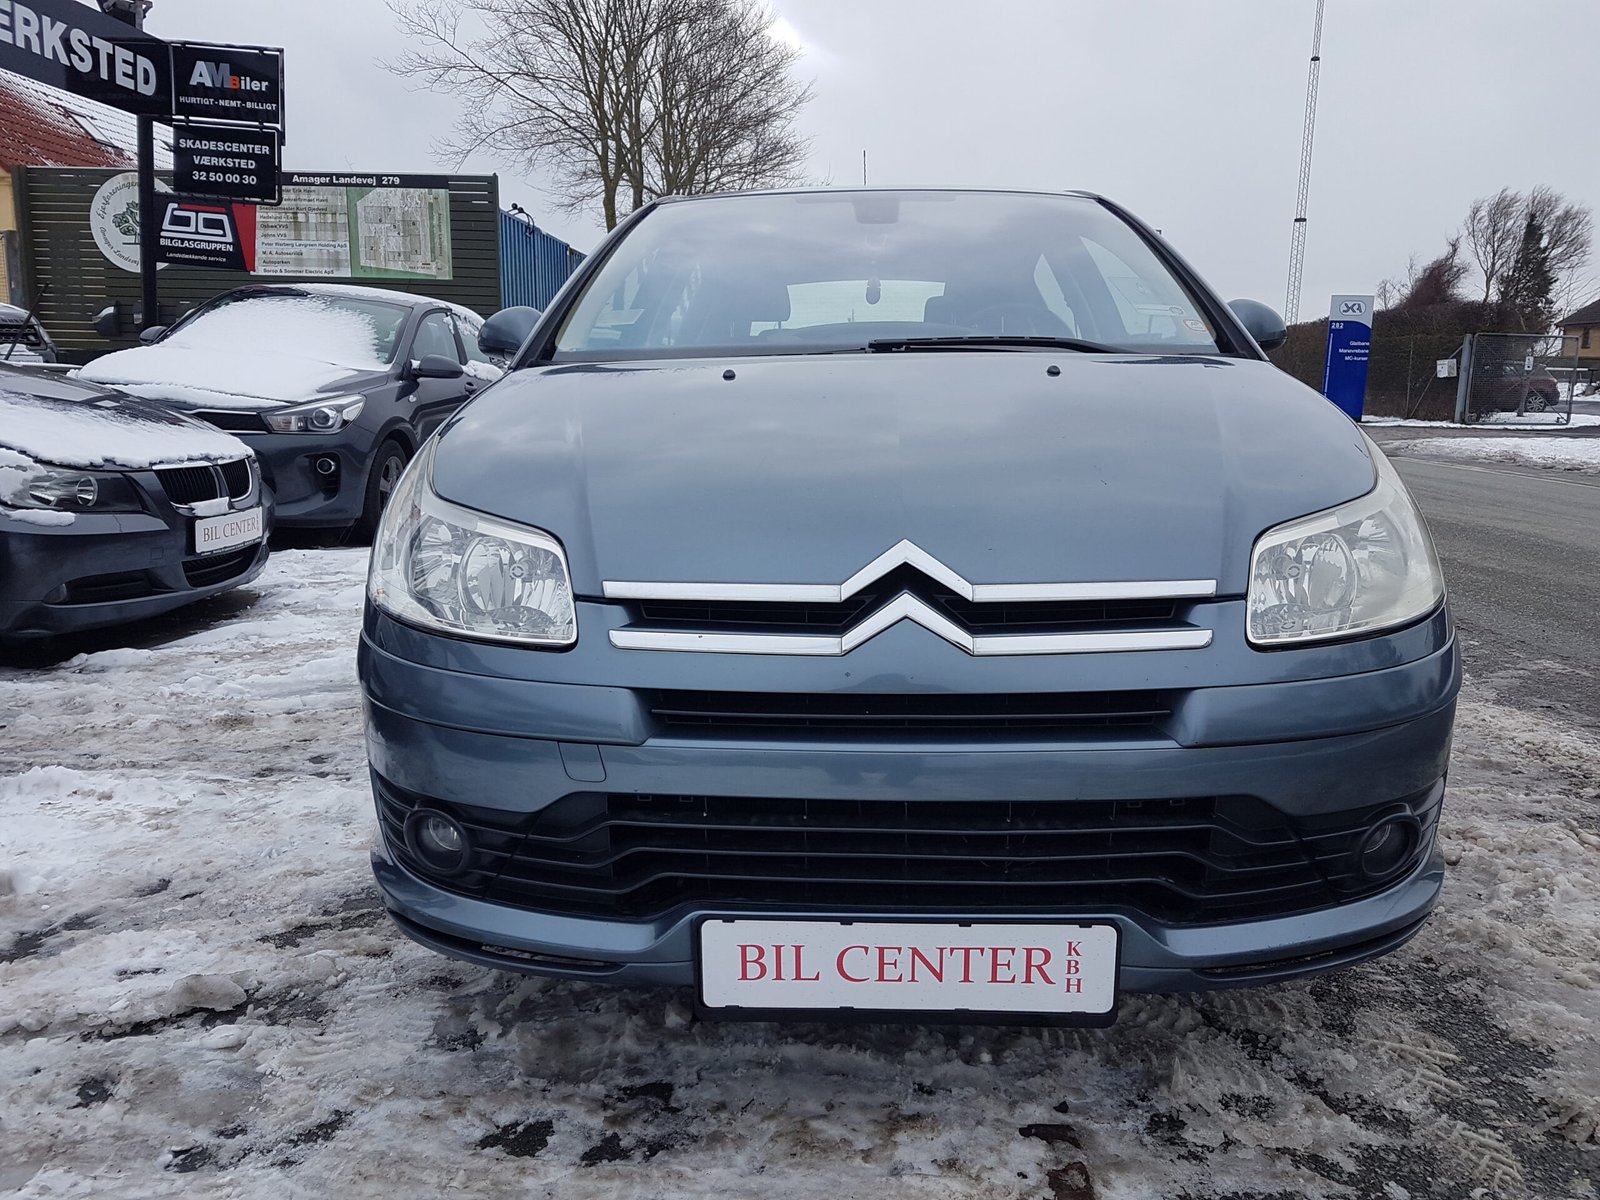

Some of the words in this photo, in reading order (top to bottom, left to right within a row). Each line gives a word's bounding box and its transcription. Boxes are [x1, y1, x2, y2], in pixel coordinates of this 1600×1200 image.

[179, 139, 270, 154] SKADESCENTER
[193, 155, 256, 169] VÆRKSTED
[192, 170, 207, 181] 32
[209, 172, 224, 182] 50
[225, 173, 240, 183] 00
[242, 175, 257, 184] 30
[292, 174, 330, 185] Amager
[332, 175, 377, 186] Landevej
[381, 176, 400, 185] 279
[160, 238, 233, 252] BILGLASGRUPPEN
[203, 526, 221, 542] BIL
[222, 516, 256, 538] CENTER
[736, 943, 820, 982] BIL
[836, 944, 1056, 986] CENTER
